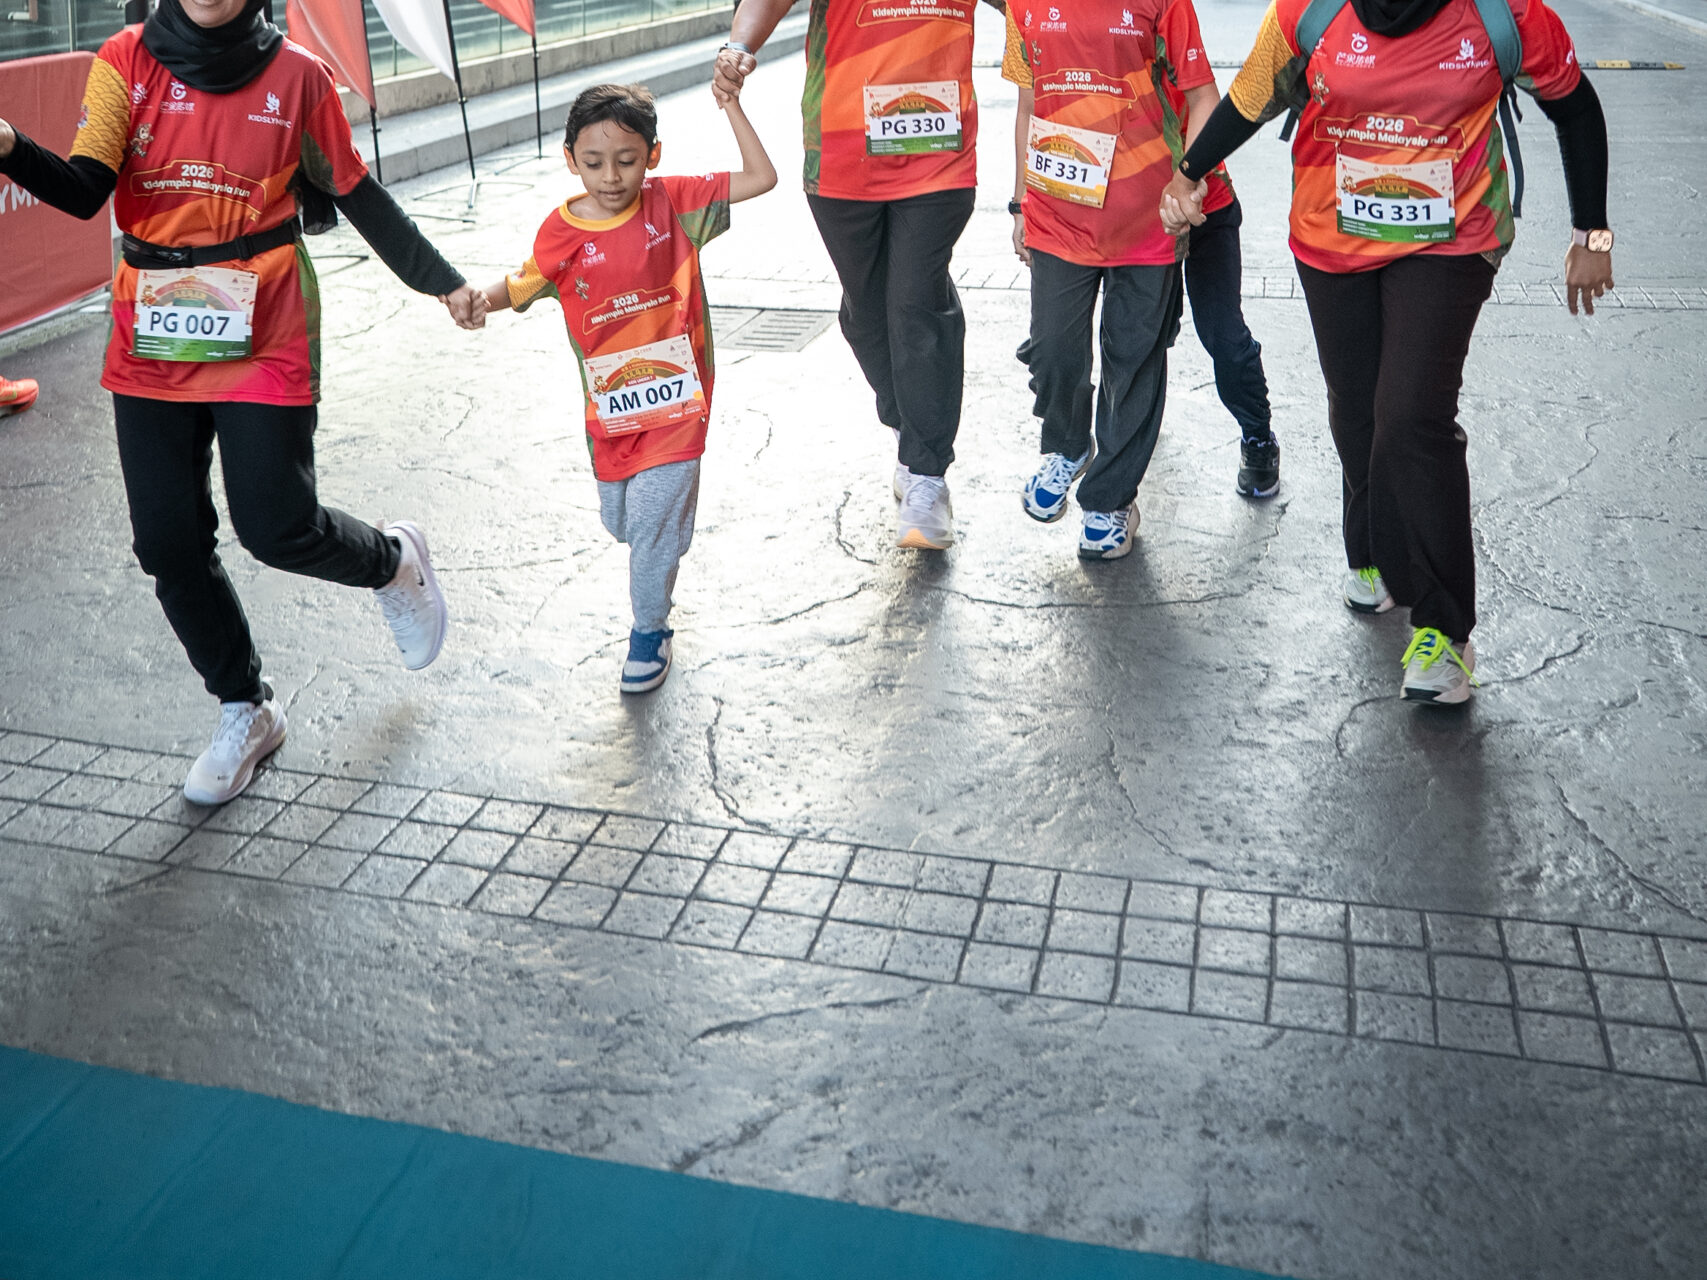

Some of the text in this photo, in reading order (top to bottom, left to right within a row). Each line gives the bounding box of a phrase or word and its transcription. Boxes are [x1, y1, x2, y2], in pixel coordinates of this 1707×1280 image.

[1065, 71, 1091, 82] 2026
[881, 117, 945, 136] PG 330
[1366, 116, 1405, 133] 2026
[181, 164, 215, 179] 2026
[1035, 154, 1052, 173] BF
[1055, 162, 1088, 184] 331
[1354, 199, 1431, 221] PG 331
[612, 293, 639, 308] 2026
[150, 311, 230, 336] PG 007
[609, 391, 642, 414] AM
[646, 379, 684, 405] 007
